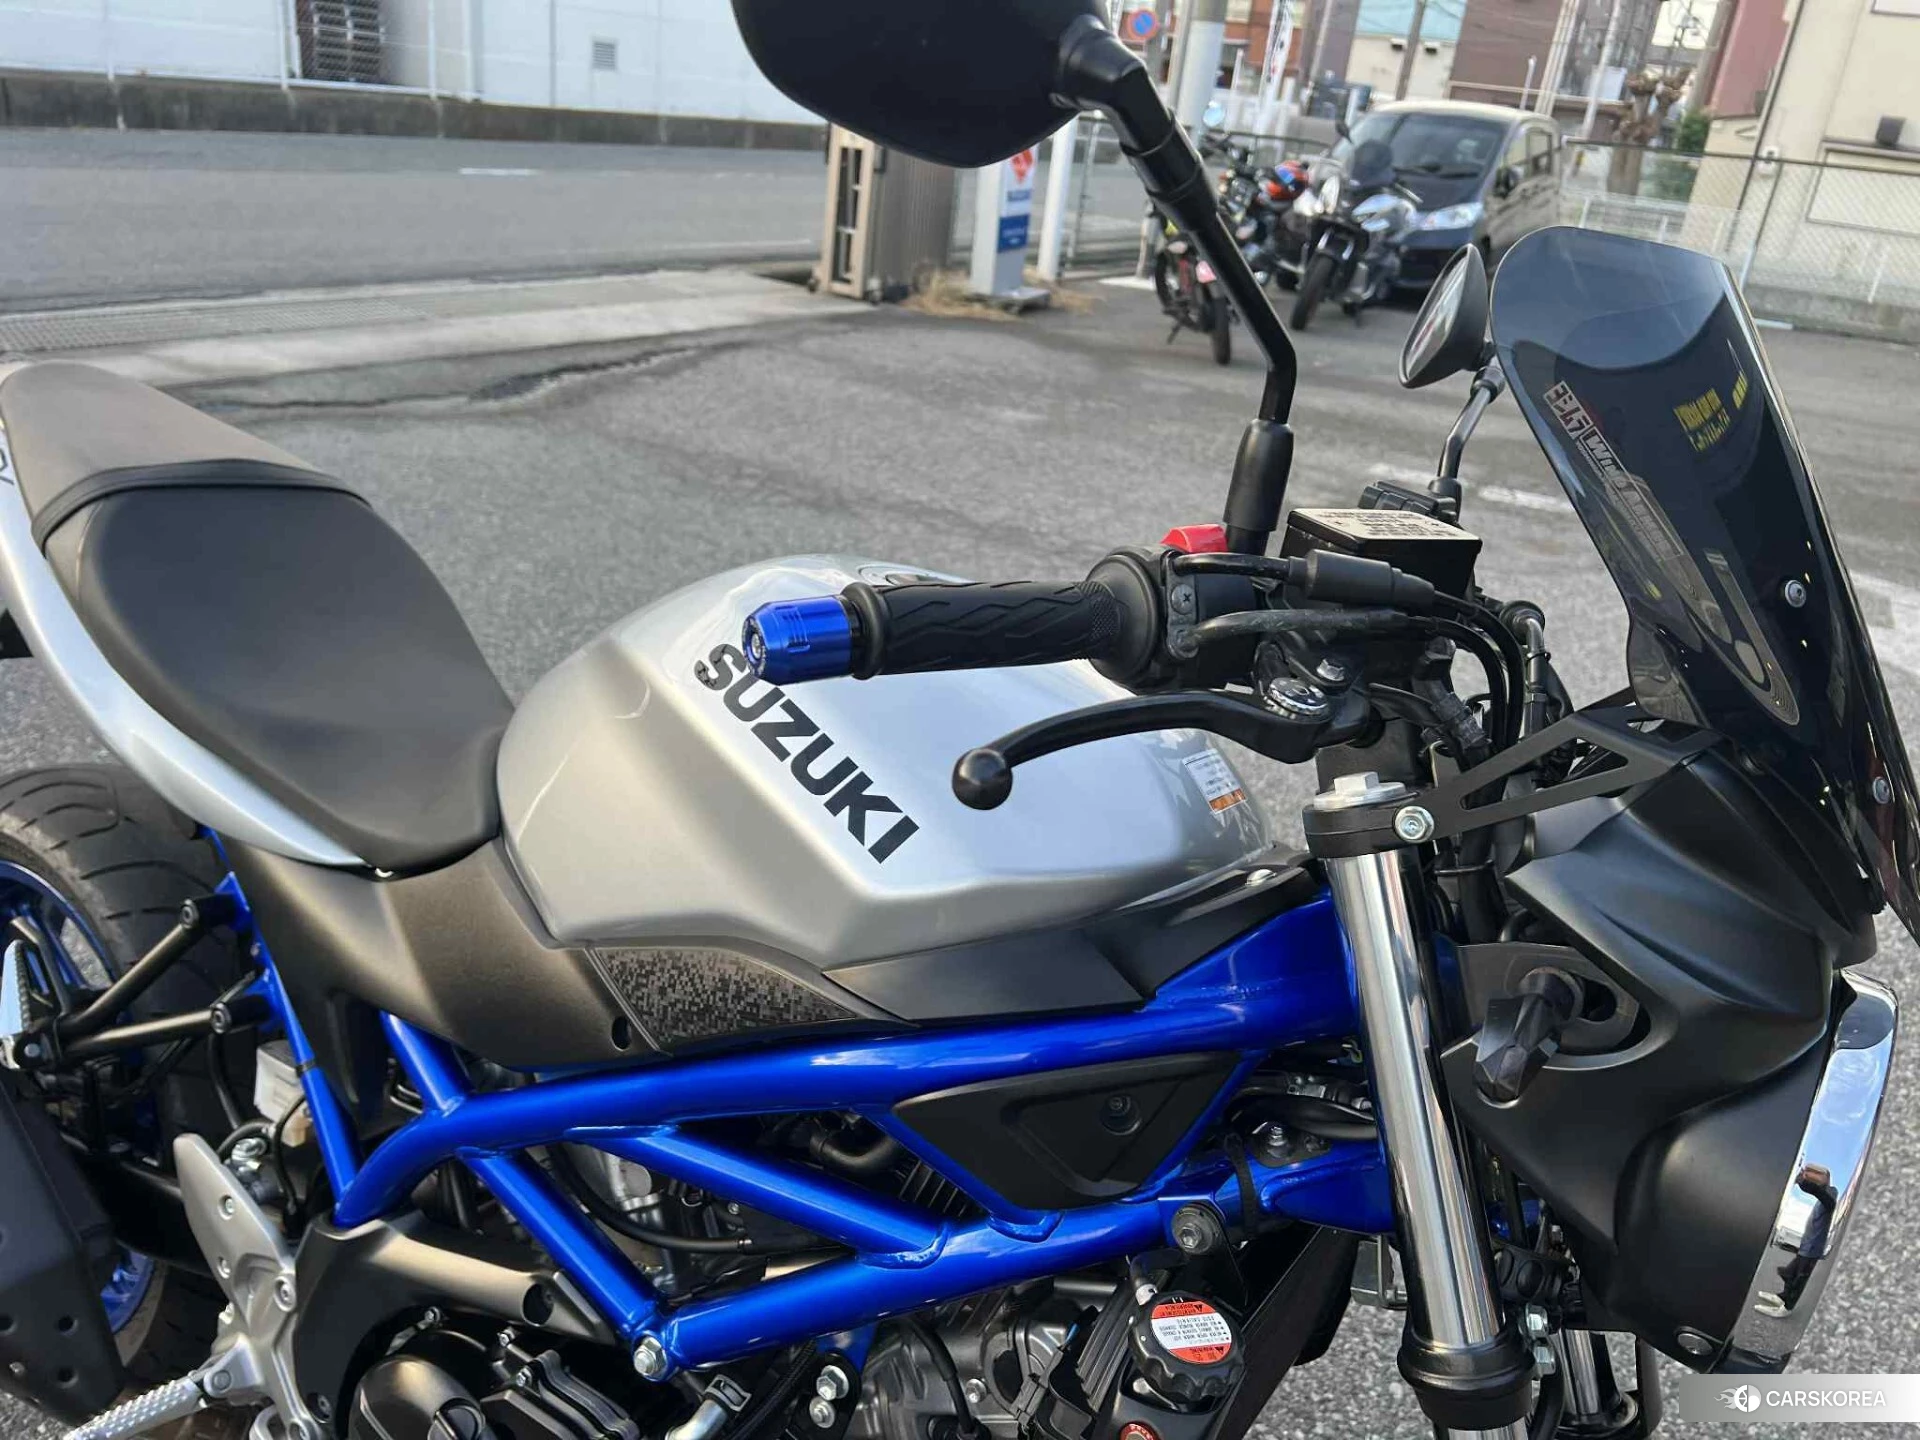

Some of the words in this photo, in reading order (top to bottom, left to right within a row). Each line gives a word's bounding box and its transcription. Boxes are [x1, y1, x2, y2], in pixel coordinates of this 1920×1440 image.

[1550, 383, 1591, 435] ヨシムラ
[694, 643, 920, 864] SUZUKI
